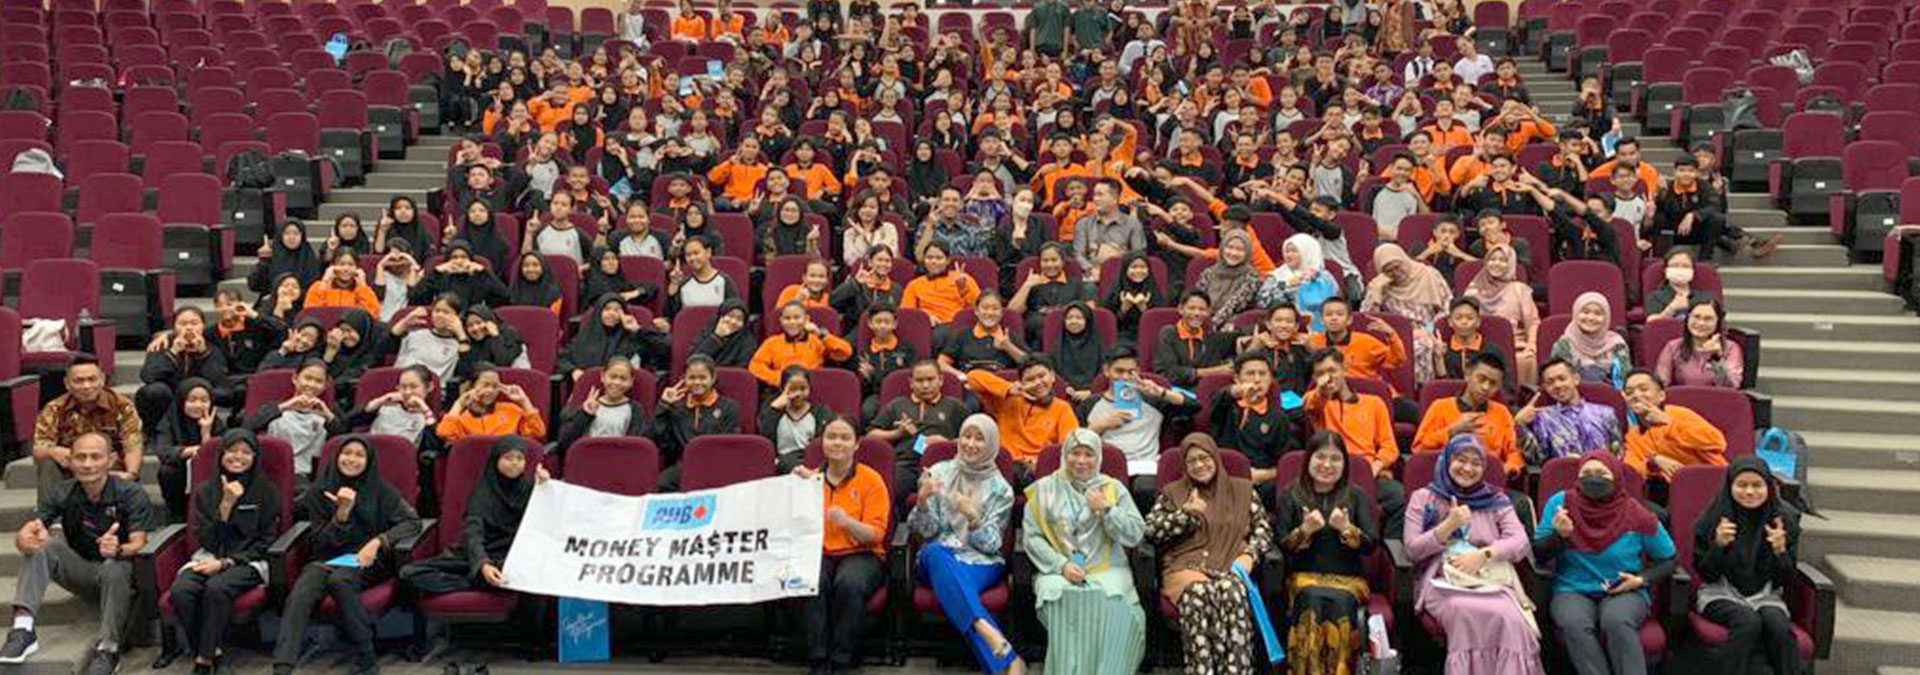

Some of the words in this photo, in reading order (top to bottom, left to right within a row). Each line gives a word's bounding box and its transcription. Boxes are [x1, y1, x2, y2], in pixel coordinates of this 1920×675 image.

[564, 535, 662, 557] MONEY
[668, 528, 769, 559] MA$TER
[578, 561, 754, 586] PROGRAMME
